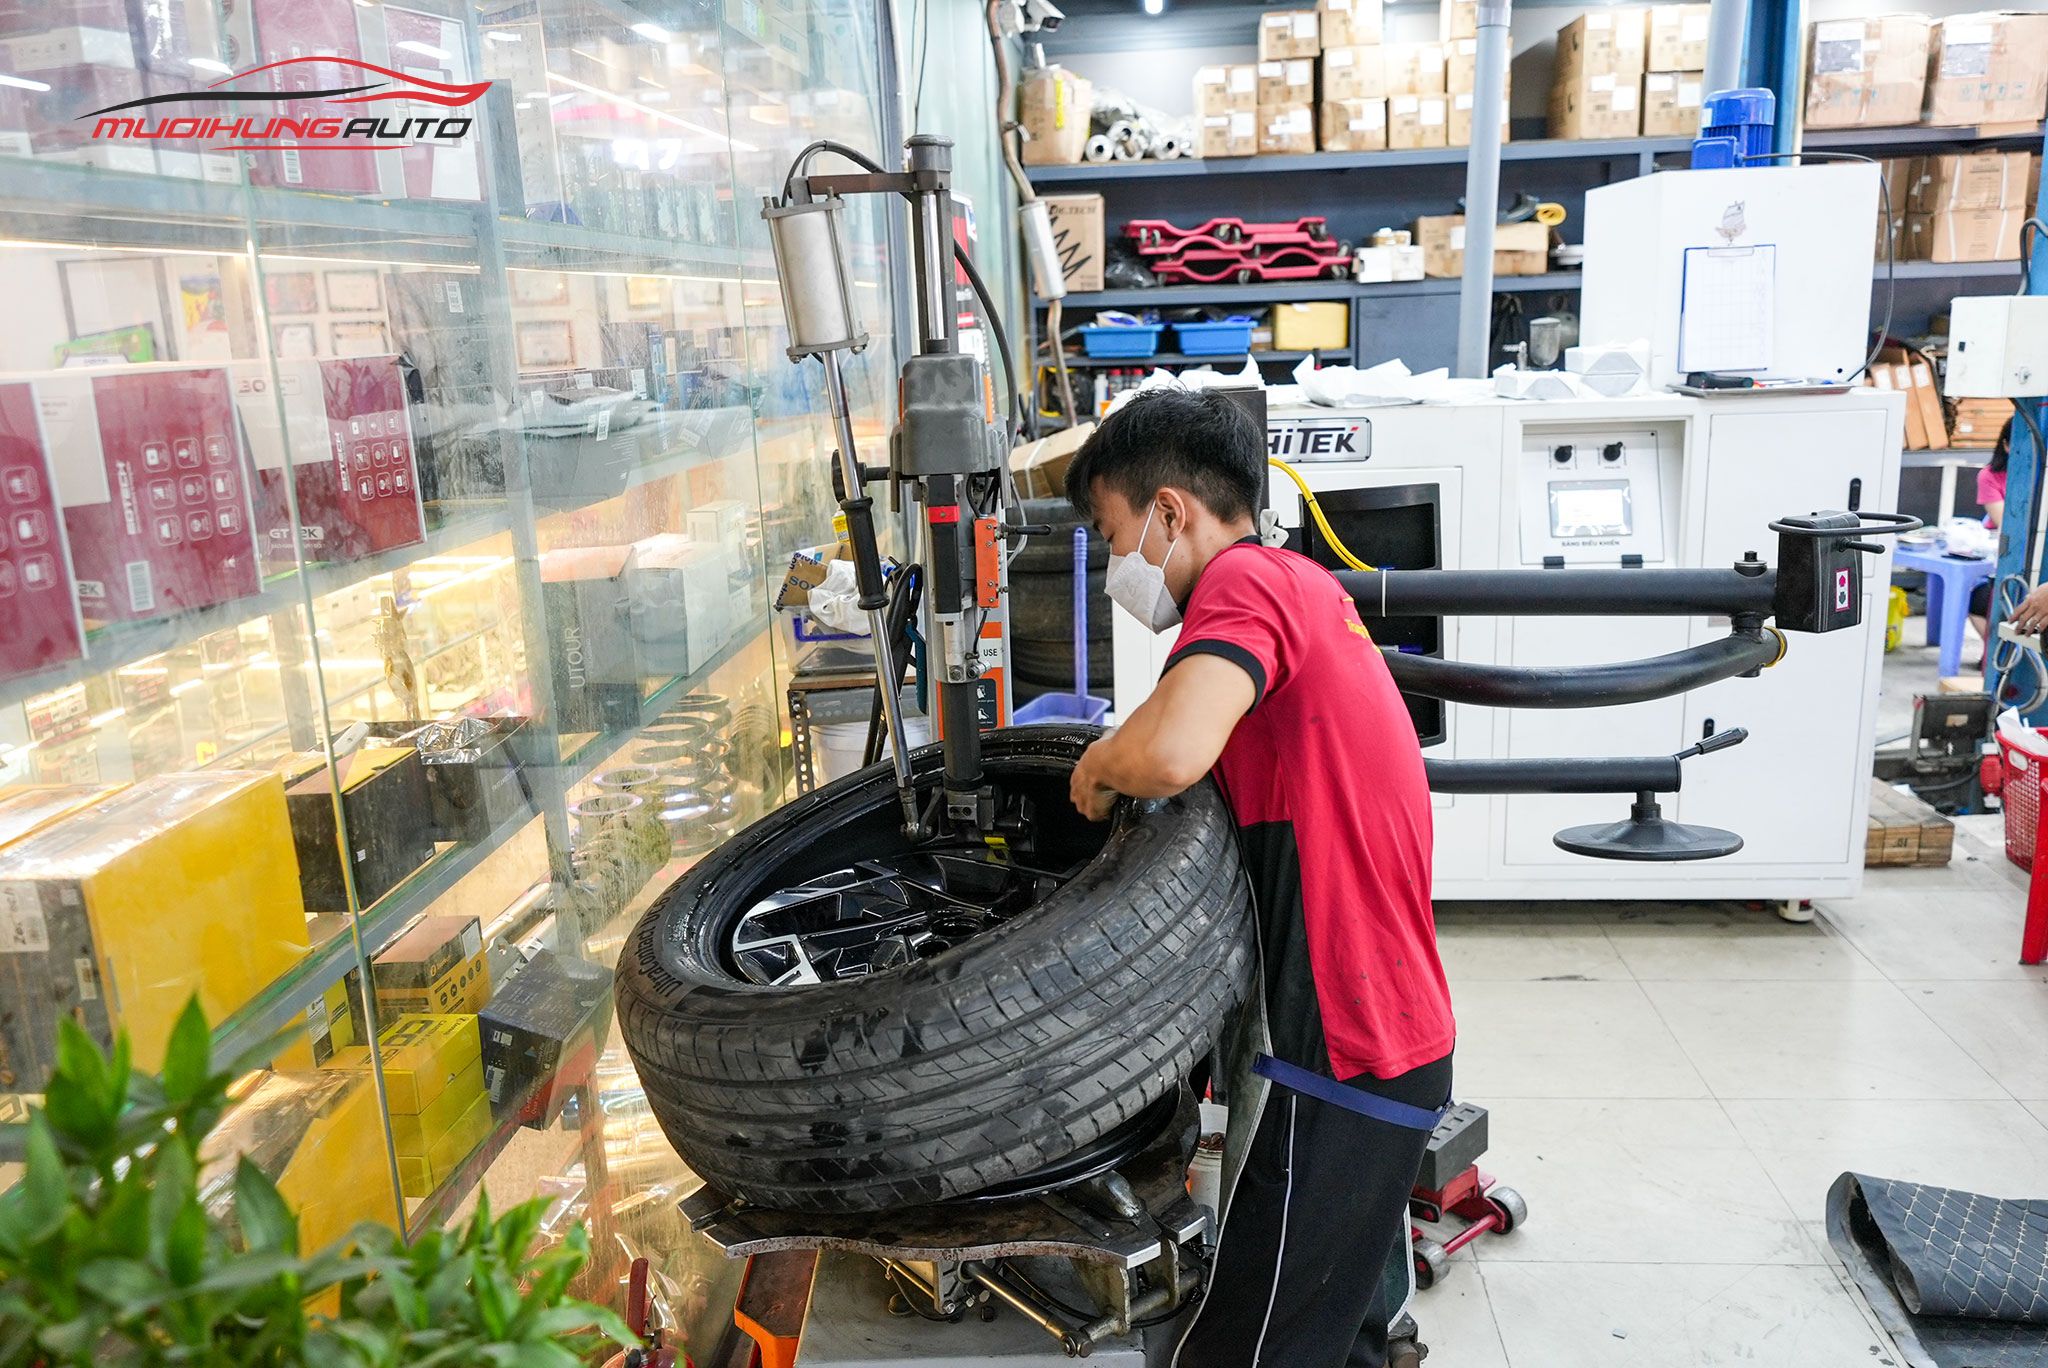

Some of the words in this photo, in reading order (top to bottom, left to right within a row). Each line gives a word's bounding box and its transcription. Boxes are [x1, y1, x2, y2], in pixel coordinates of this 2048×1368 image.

[565, 627, 585, 687] UTOUR
[983, 648, 998, 657] USE
[634, 925, 684, 998] UltraContact
